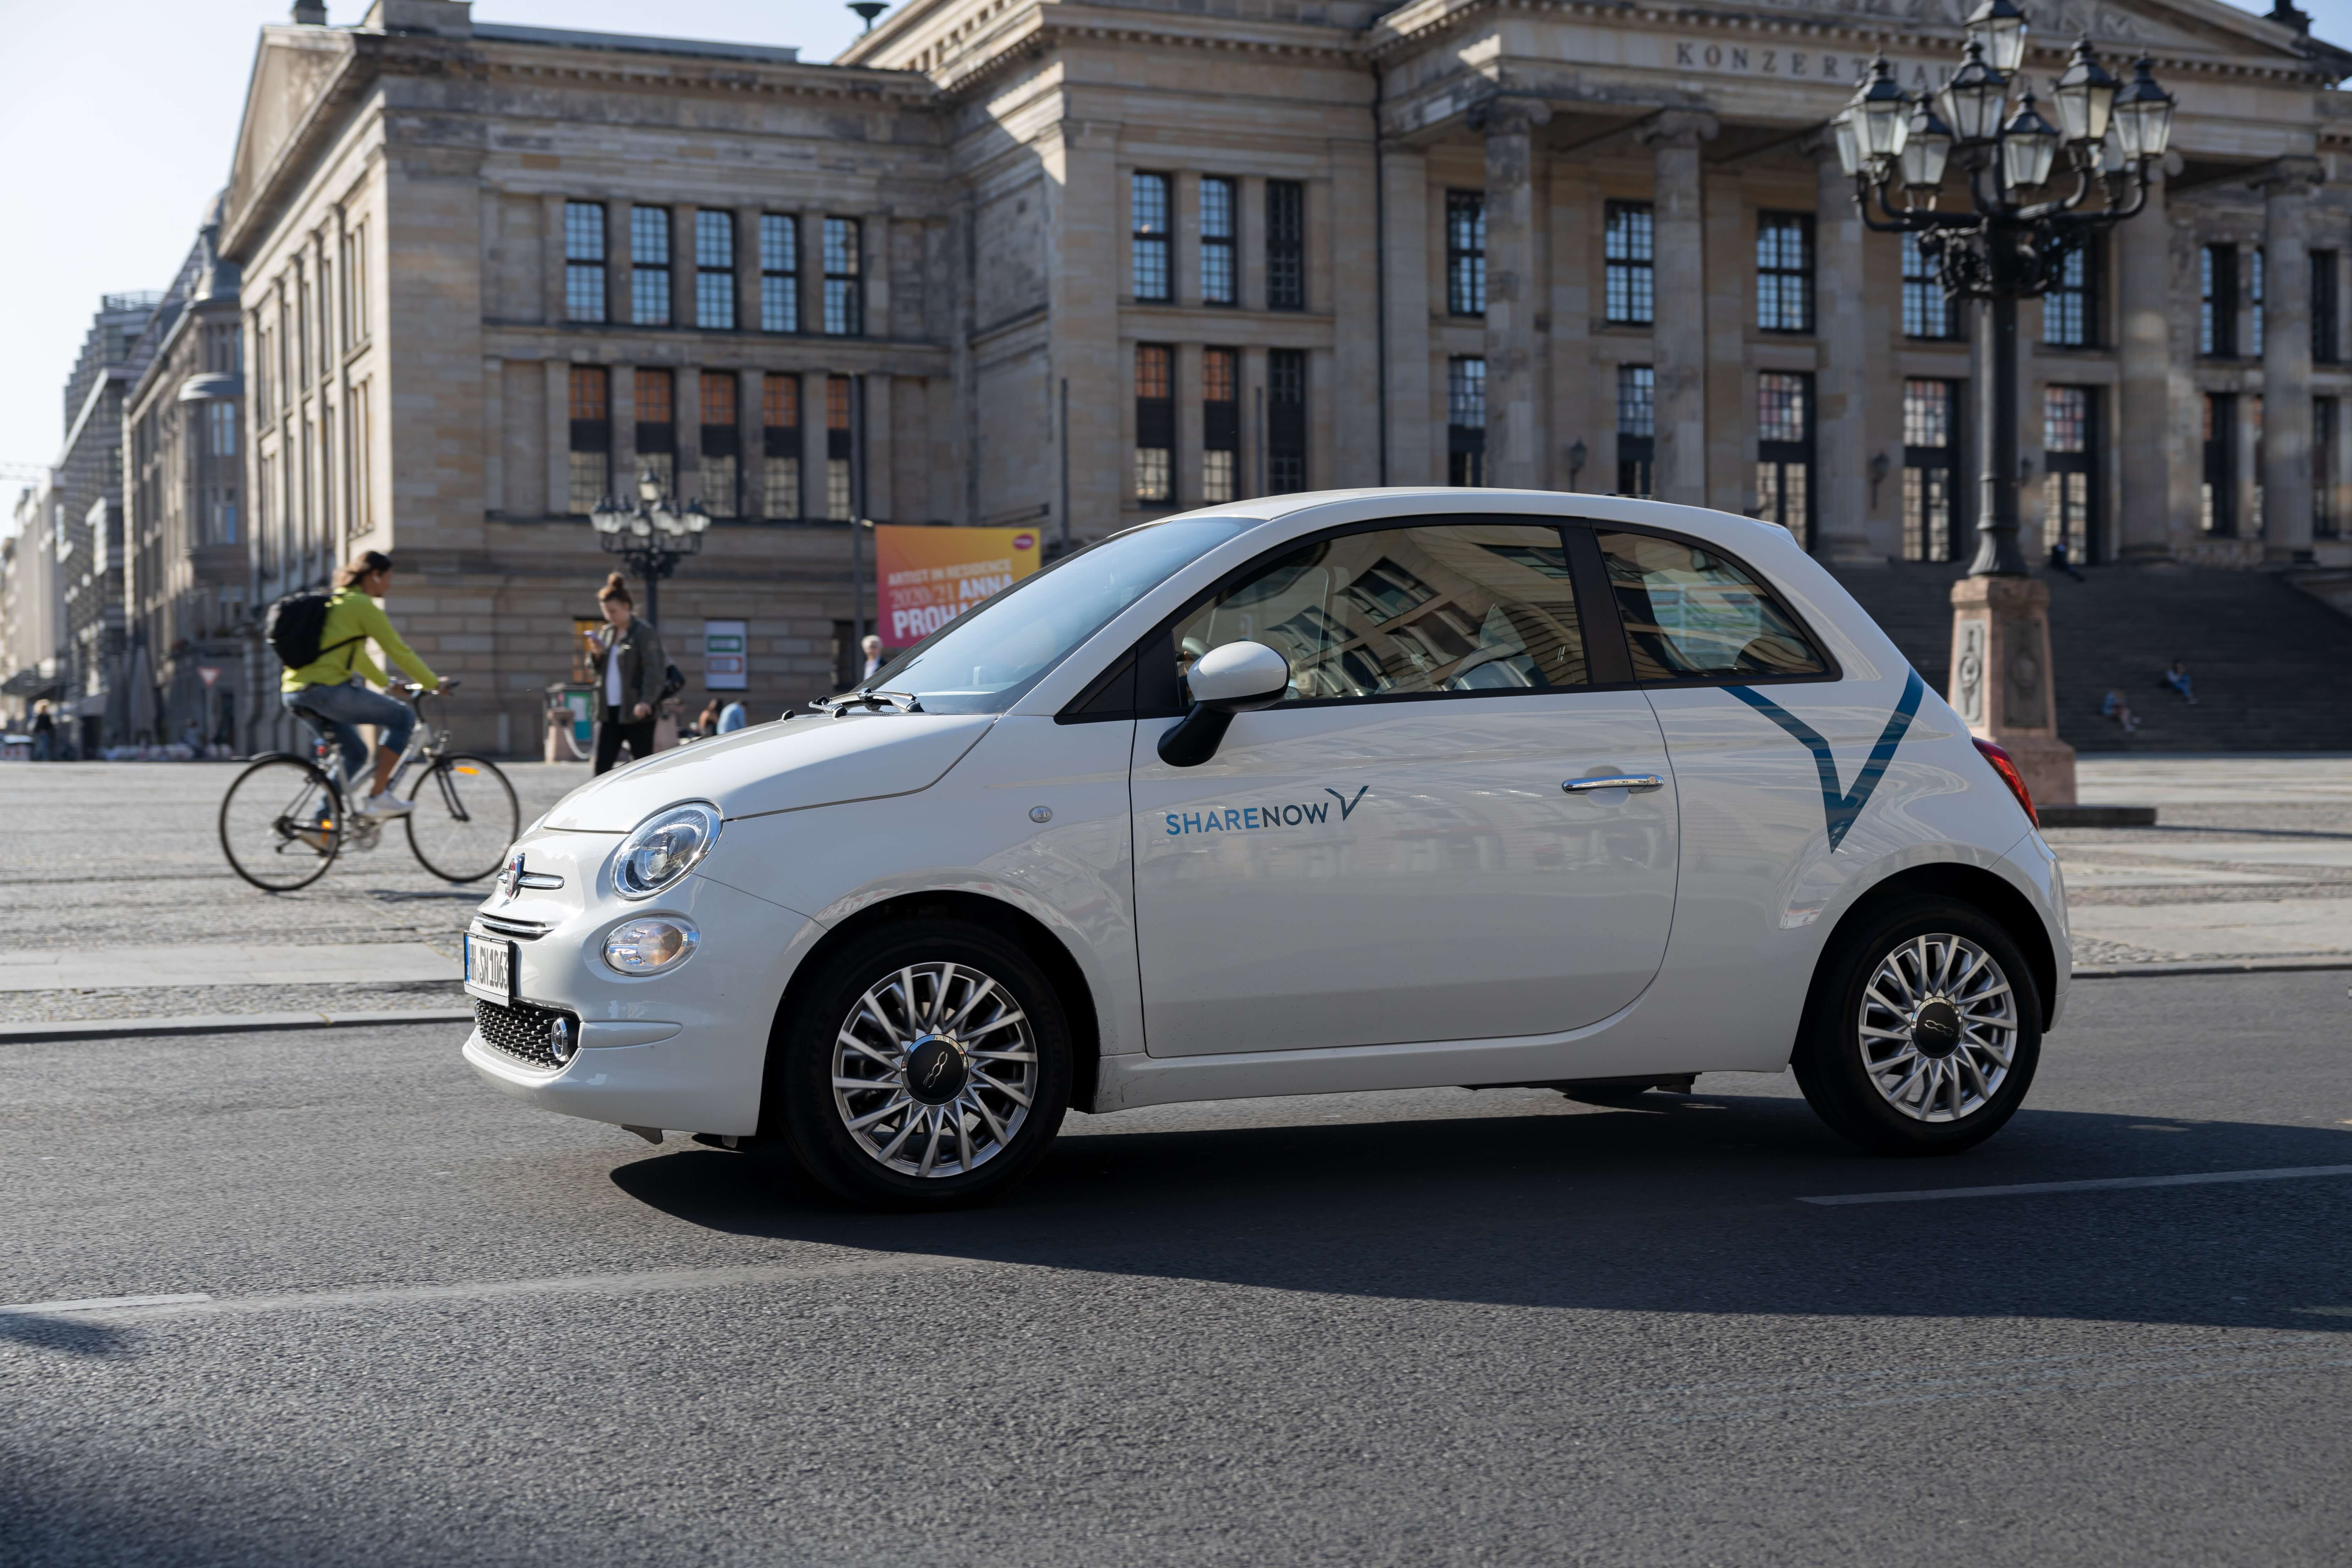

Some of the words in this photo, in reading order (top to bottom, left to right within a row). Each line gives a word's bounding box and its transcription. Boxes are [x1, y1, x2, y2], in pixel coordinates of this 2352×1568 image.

[888, 569, 929, 586] ARTIST
[931, 567, 944, 580] IN
[947, 558, 1012, 579] RESIDENCE
[1166, 802, 1329, 835] SHARENOW
[480, 946, 488, 985] SN
[490, 949, 508, 990] 1063
